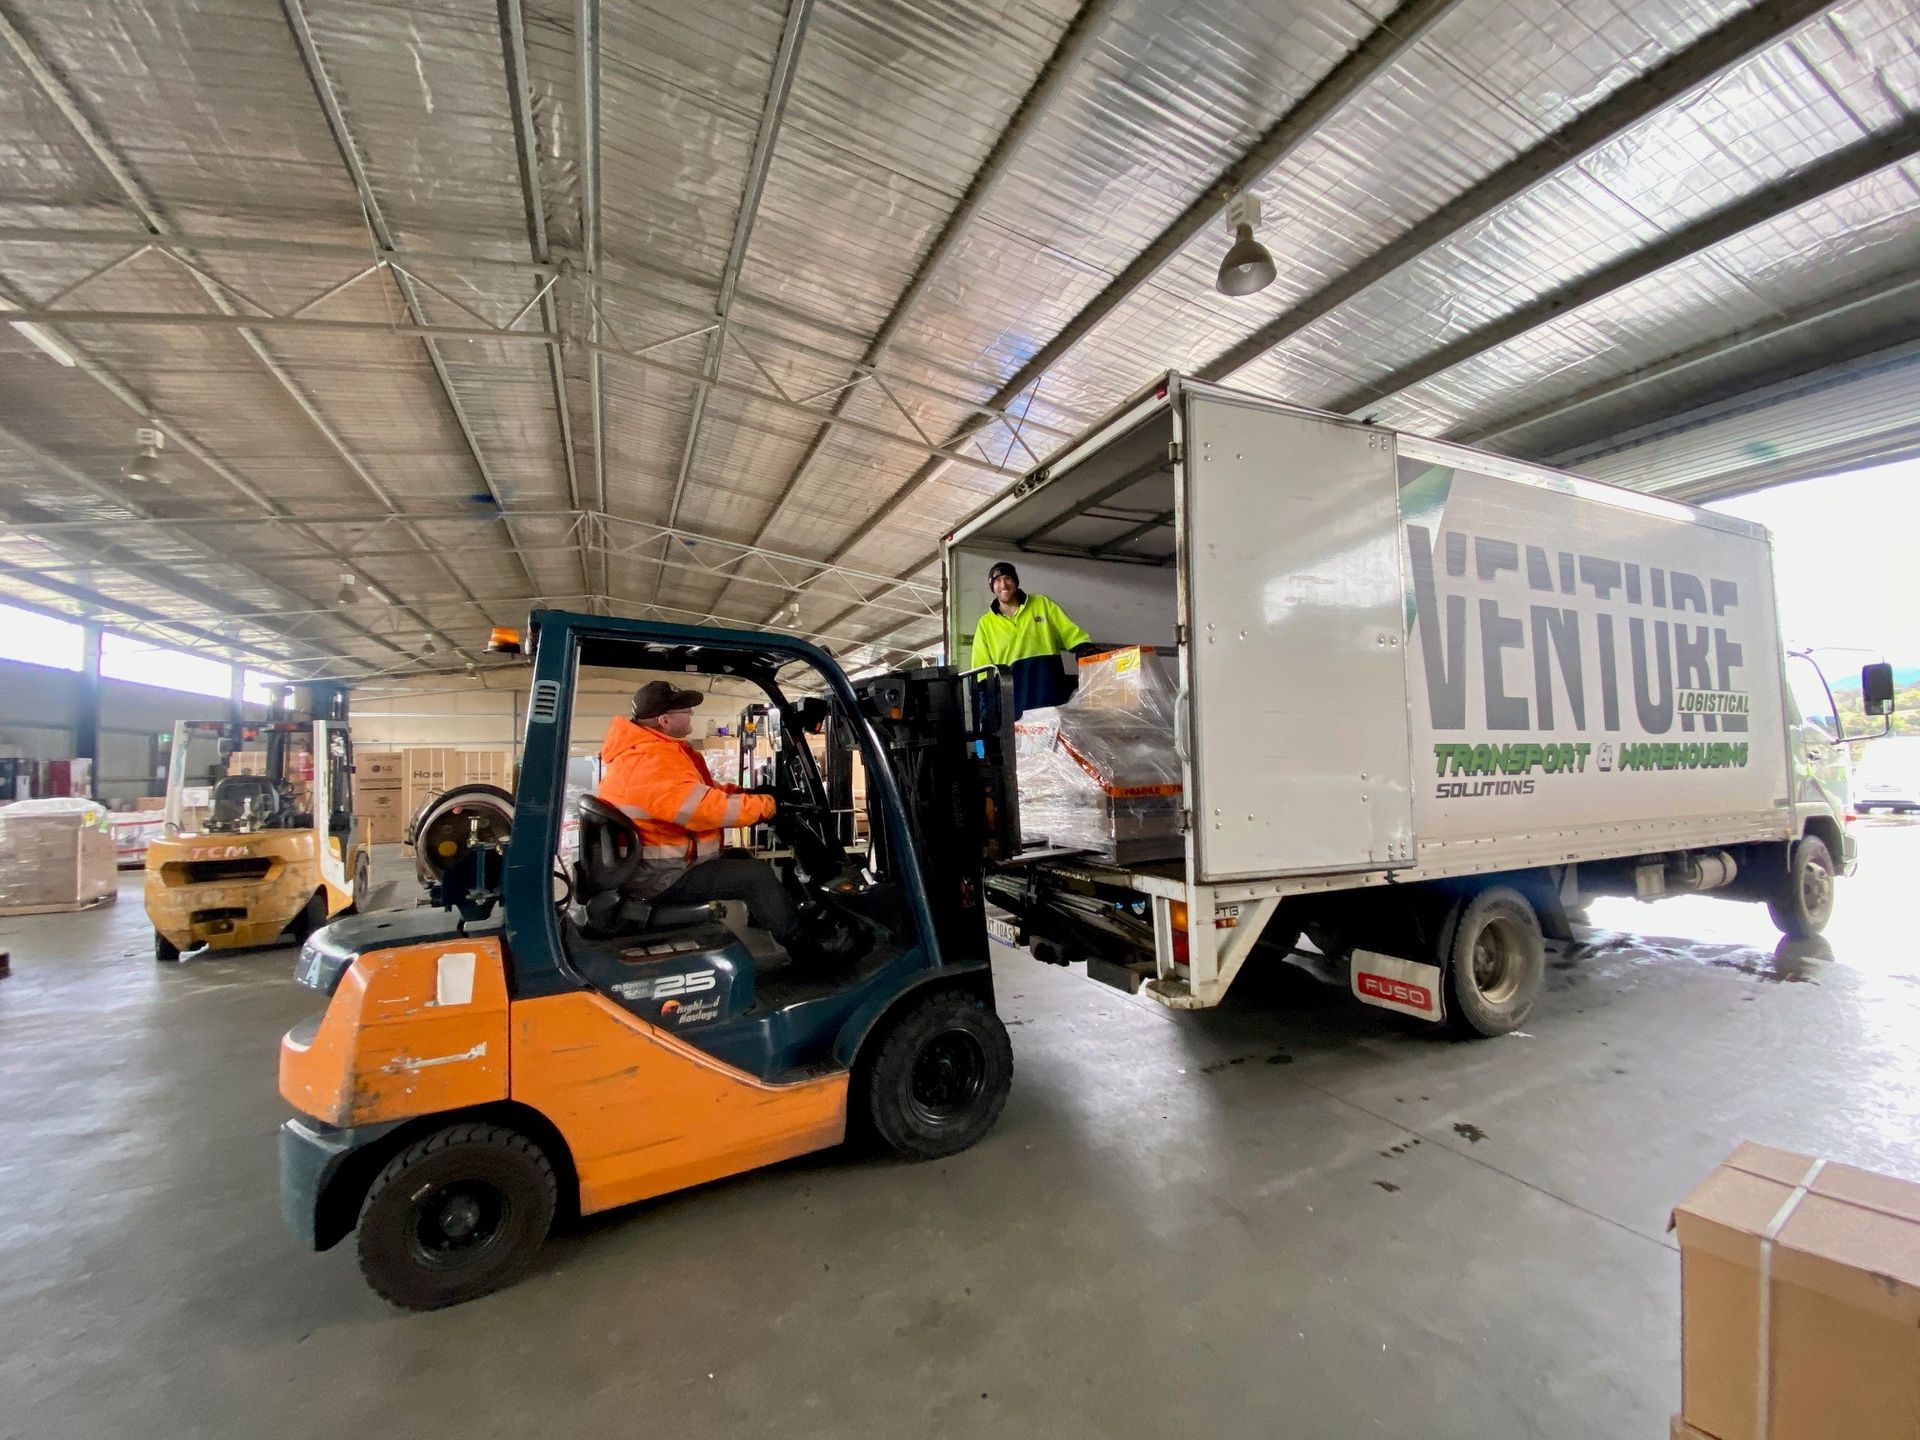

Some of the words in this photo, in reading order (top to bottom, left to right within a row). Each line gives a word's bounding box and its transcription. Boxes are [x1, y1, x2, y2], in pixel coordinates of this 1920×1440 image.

[1407, 524, 1749, 735] VENTURE
[1677, 692, 1750, 713] LOGISTICAL
[1433, 743, 1591, 777] TRANSPORT
[1618, 742, 1749, 772] WAREHOUSING
[1124, 786, 1160, 796] FRAGILE
[1435, 780, 1536, 798] SOLUTIONS
[654, 969, 716, 999] 25
[1365, 978, 1426, 1004] FUSO
